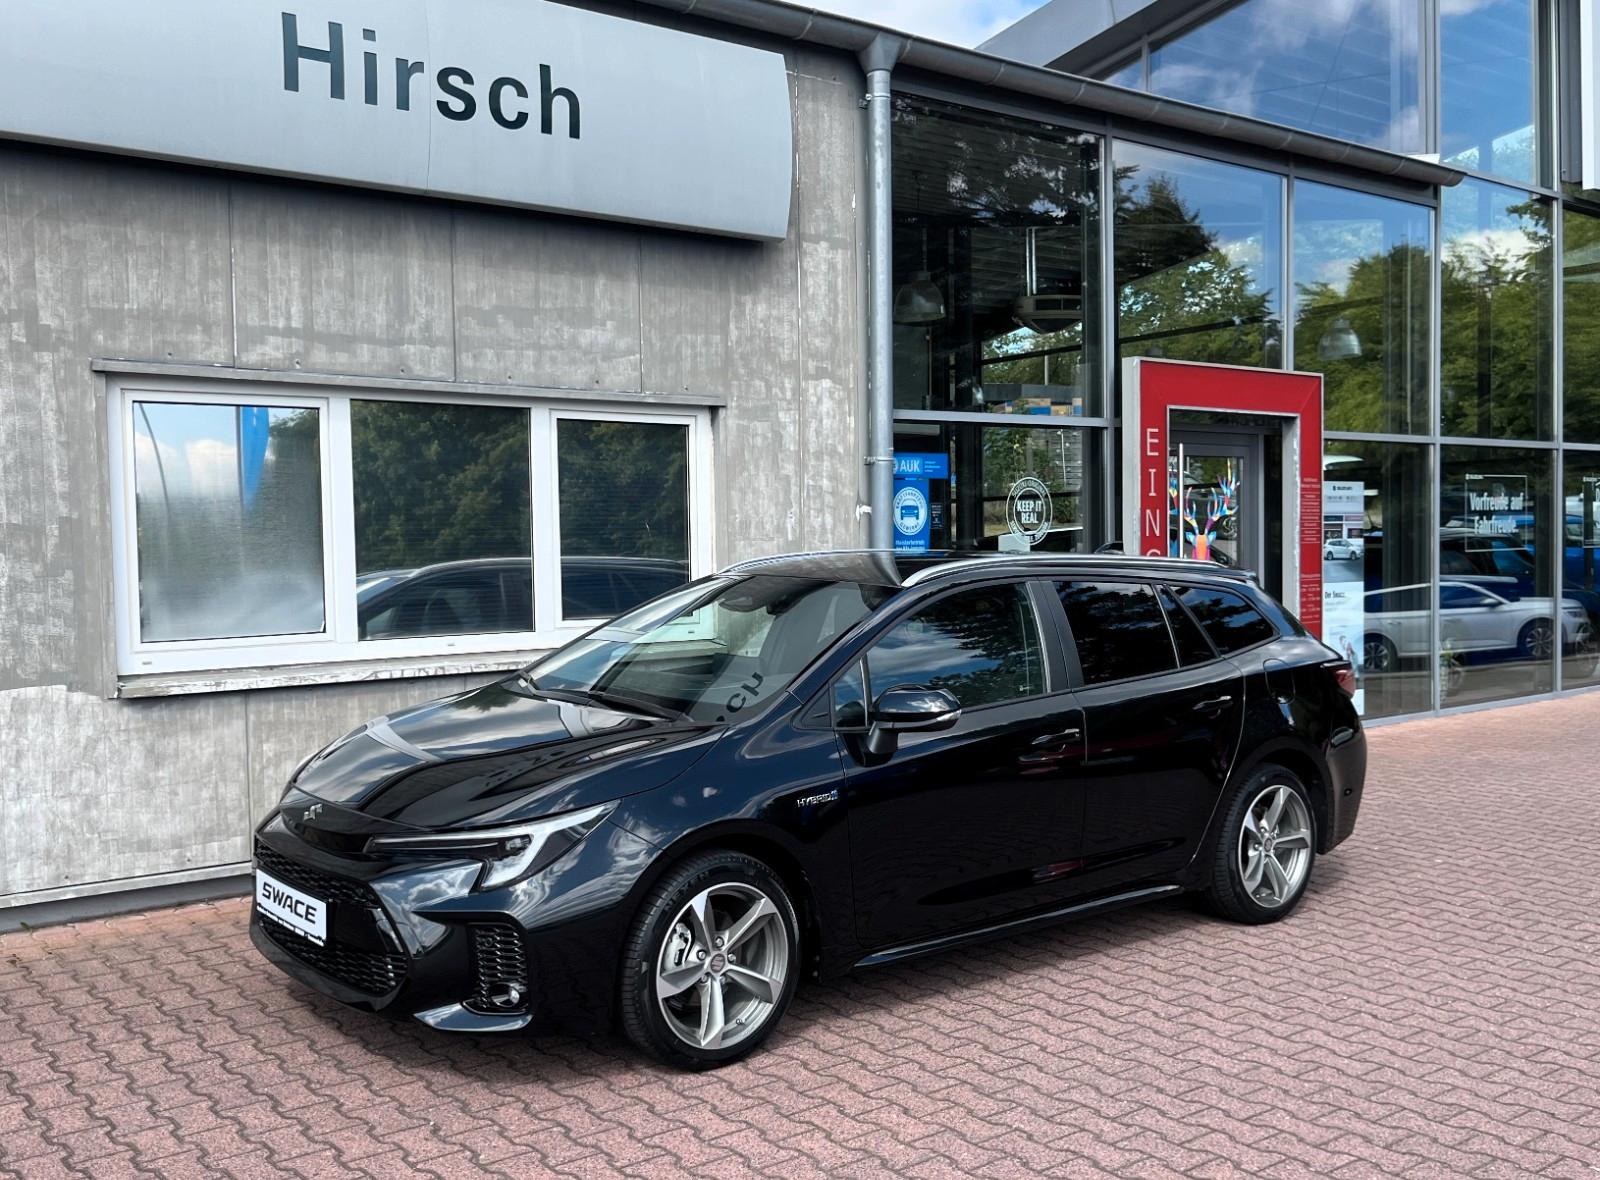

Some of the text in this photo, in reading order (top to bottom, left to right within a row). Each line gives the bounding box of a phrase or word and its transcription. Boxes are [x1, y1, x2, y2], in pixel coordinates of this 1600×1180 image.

[281, 12, 581, 139] Hirsch
[1017, 500, 1042, 512] KEEP IT
[1469, 492, 1525, 511] Vorfreude auf
[1021, 512, 1039, 523] REAL
[262, 881, 317, 924] SWACE
